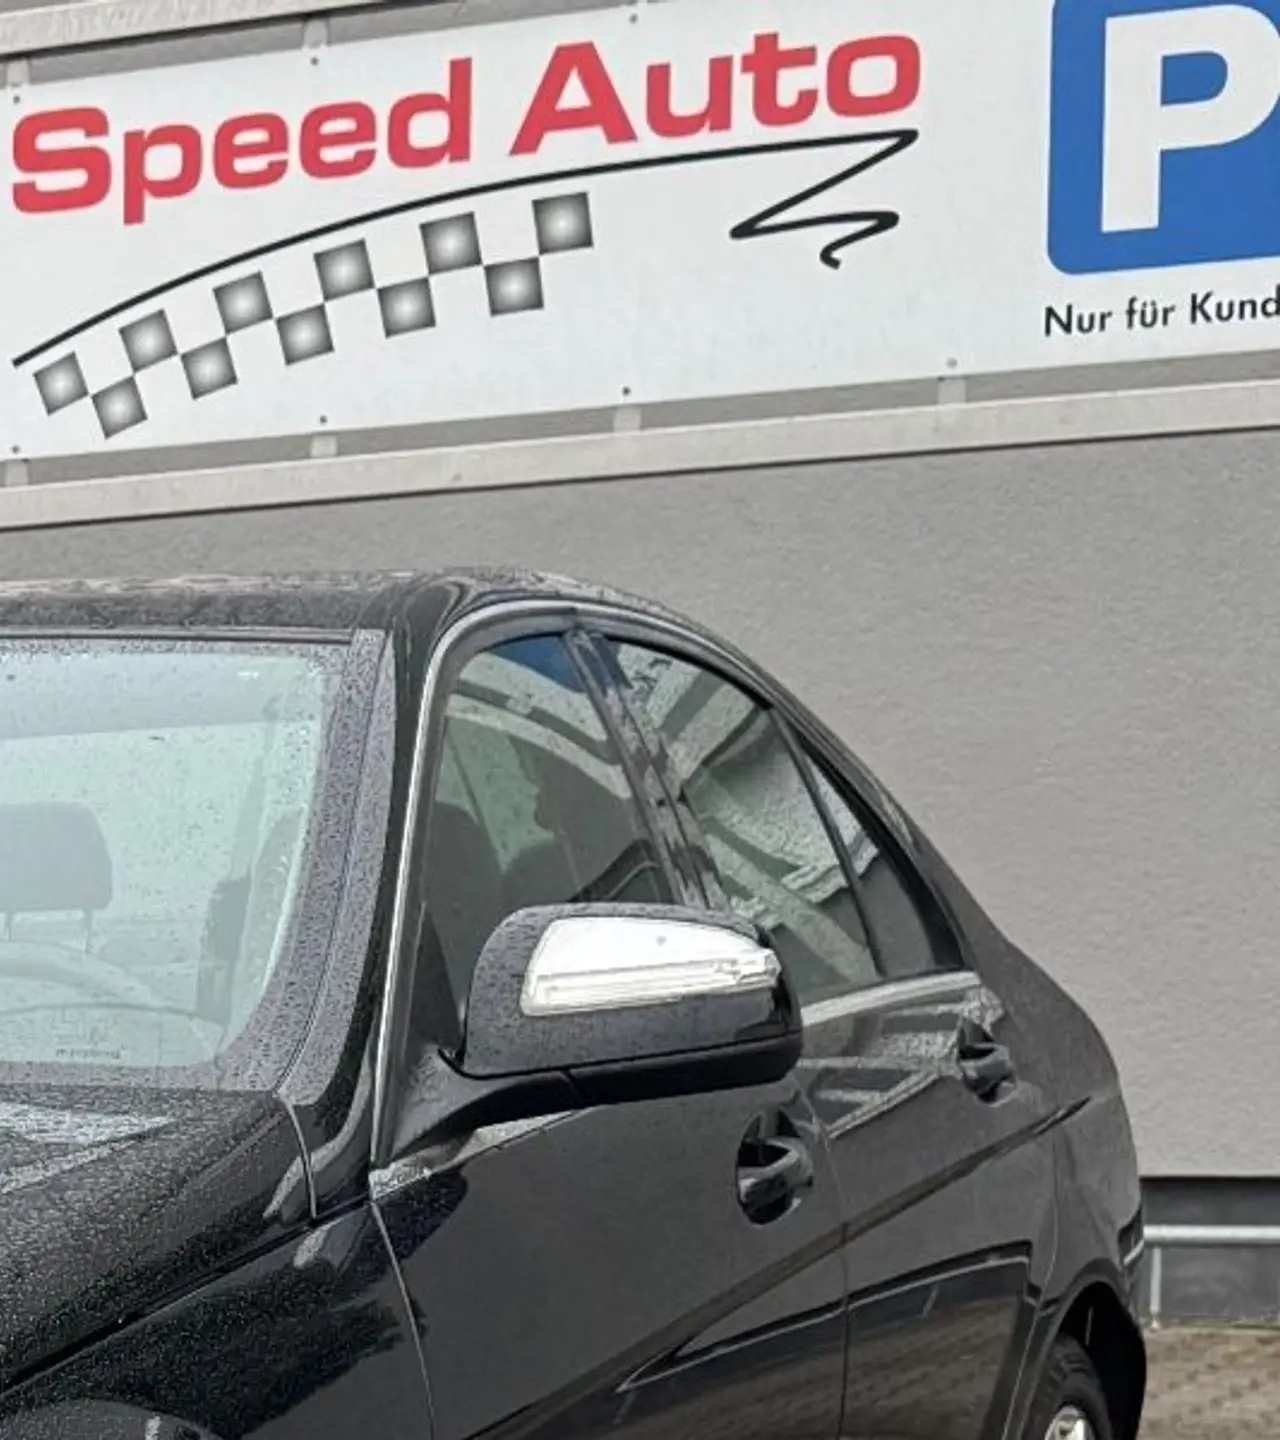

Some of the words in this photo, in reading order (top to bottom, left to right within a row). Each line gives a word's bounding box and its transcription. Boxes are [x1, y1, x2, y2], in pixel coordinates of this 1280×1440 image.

[11, 57, 474, 225] Speed
[512, 33, 921, 155] Auto
[1101, 4, 1280, 233] P
[1044, 303, 1114, 337] Nur
[1125, 295, 1176, 329] für
